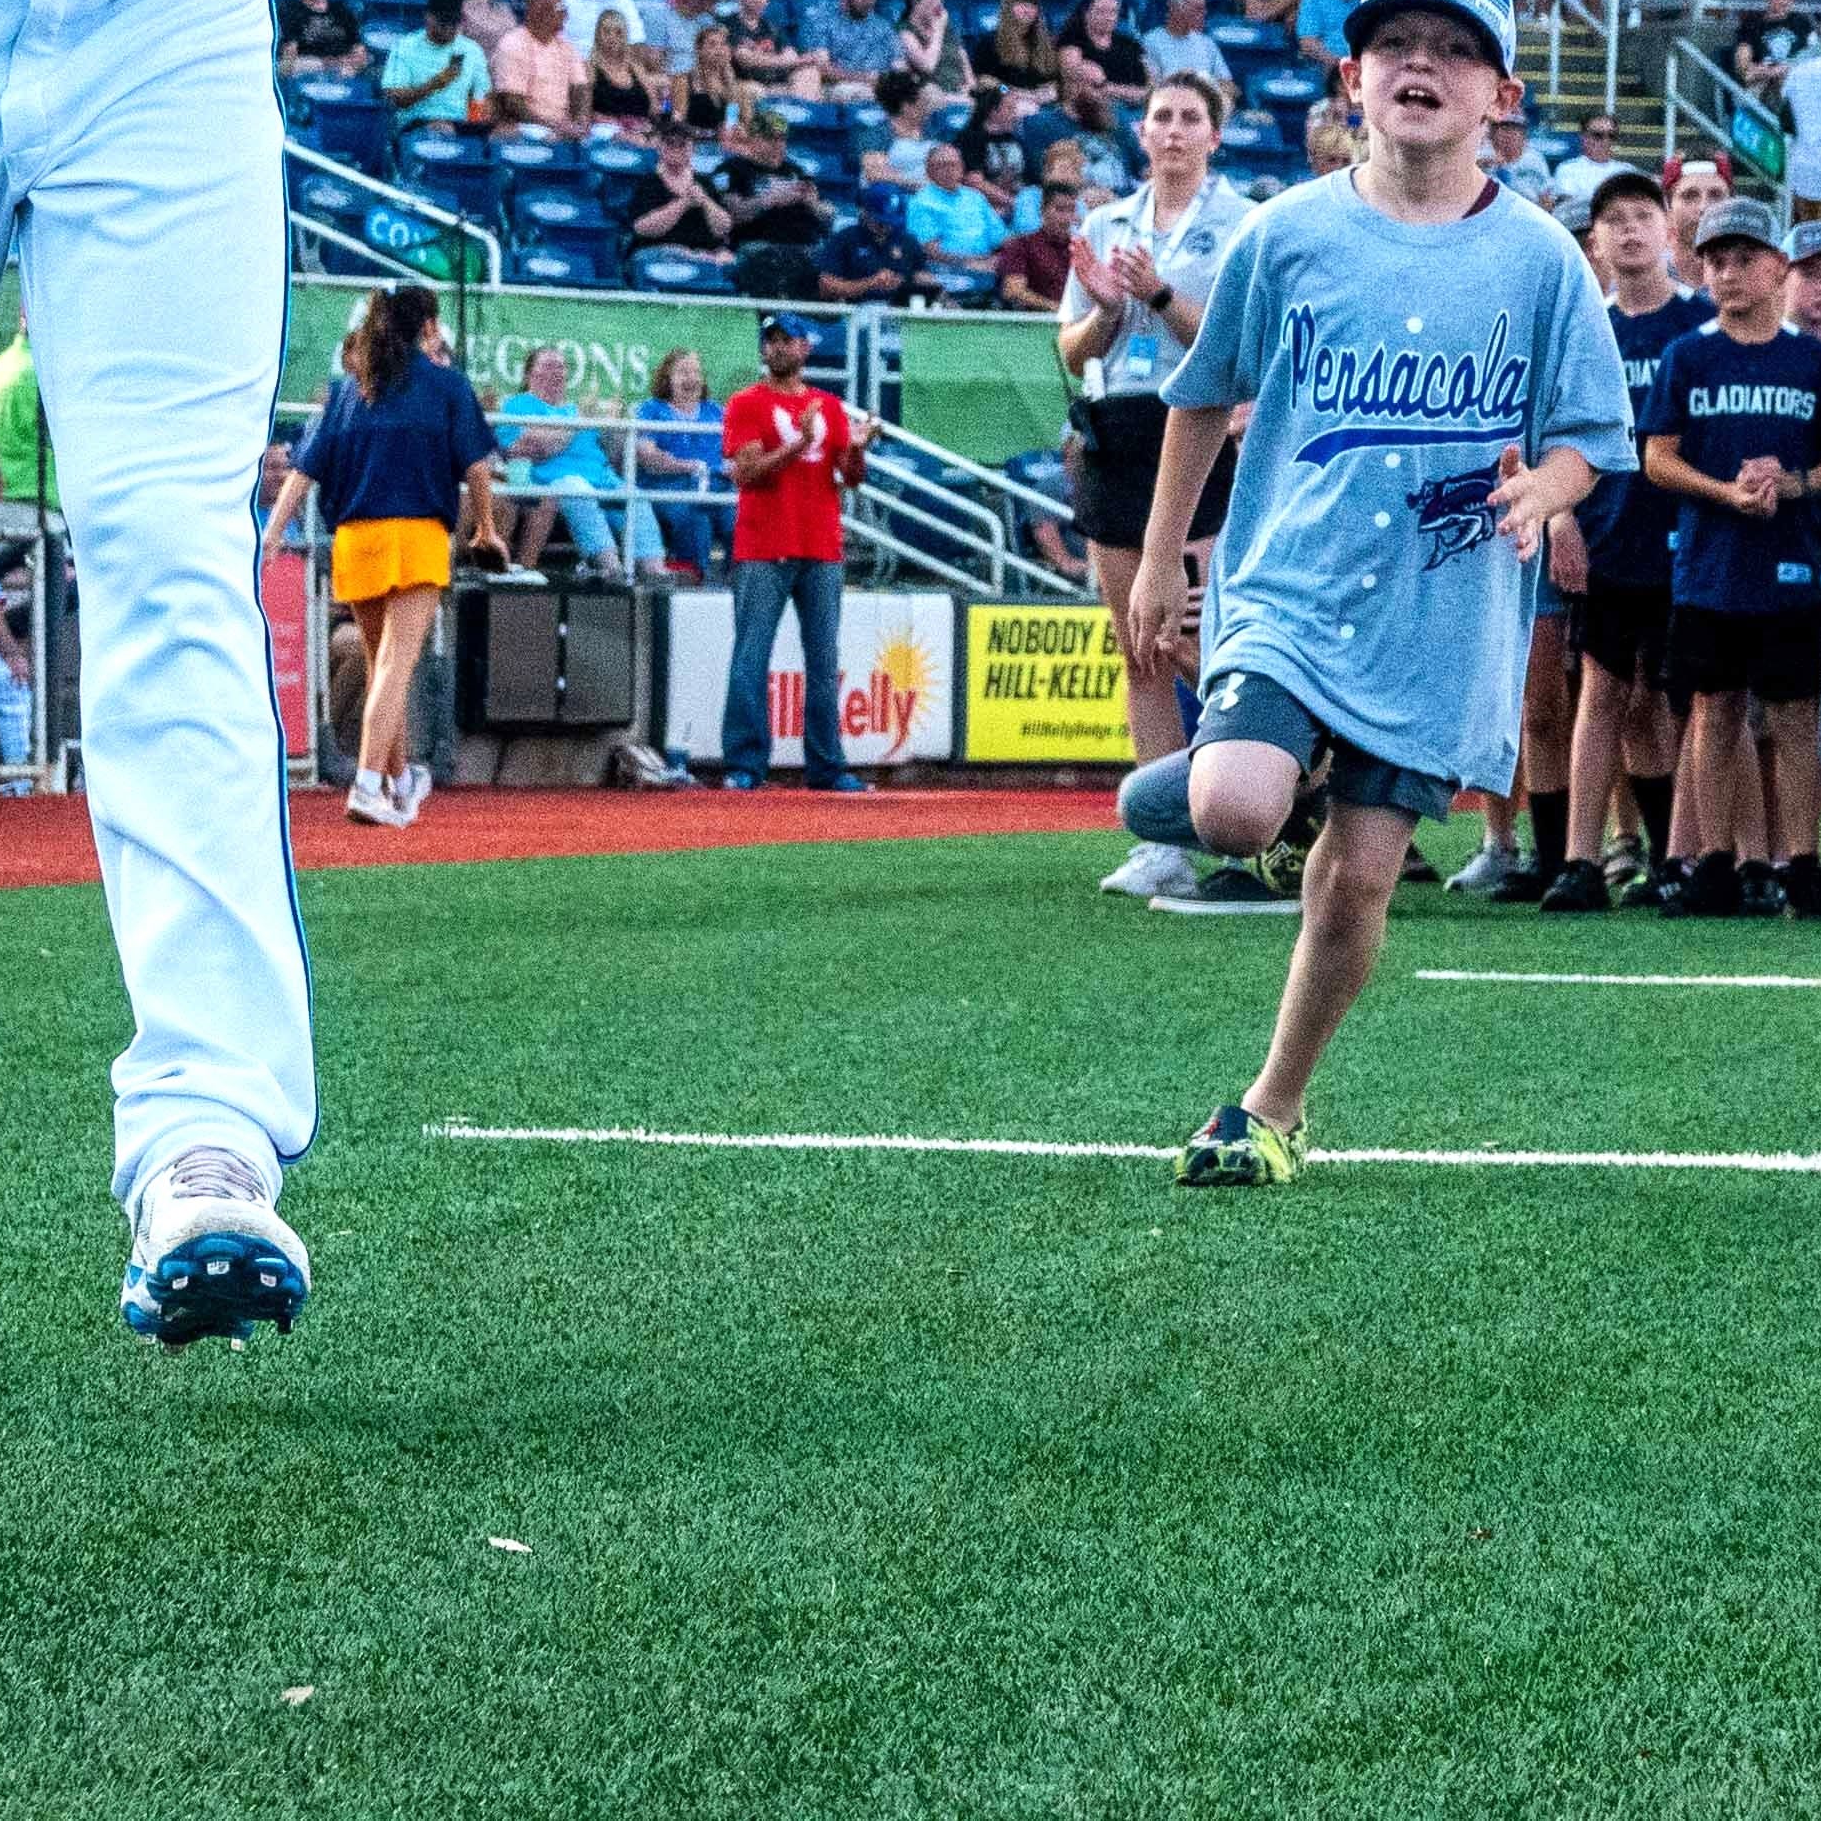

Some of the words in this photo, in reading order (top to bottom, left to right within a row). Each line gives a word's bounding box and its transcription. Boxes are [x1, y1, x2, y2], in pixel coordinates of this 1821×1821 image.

[1280, 299, 1531, 420] Pensacola
[1688, 384, 1817, 421] GLADIATORS
[987, 617, 1095, 656] NOBODY
[983, 660, 1123, 700] HILL-KELLY
[836, 668, 917, 761] elly
